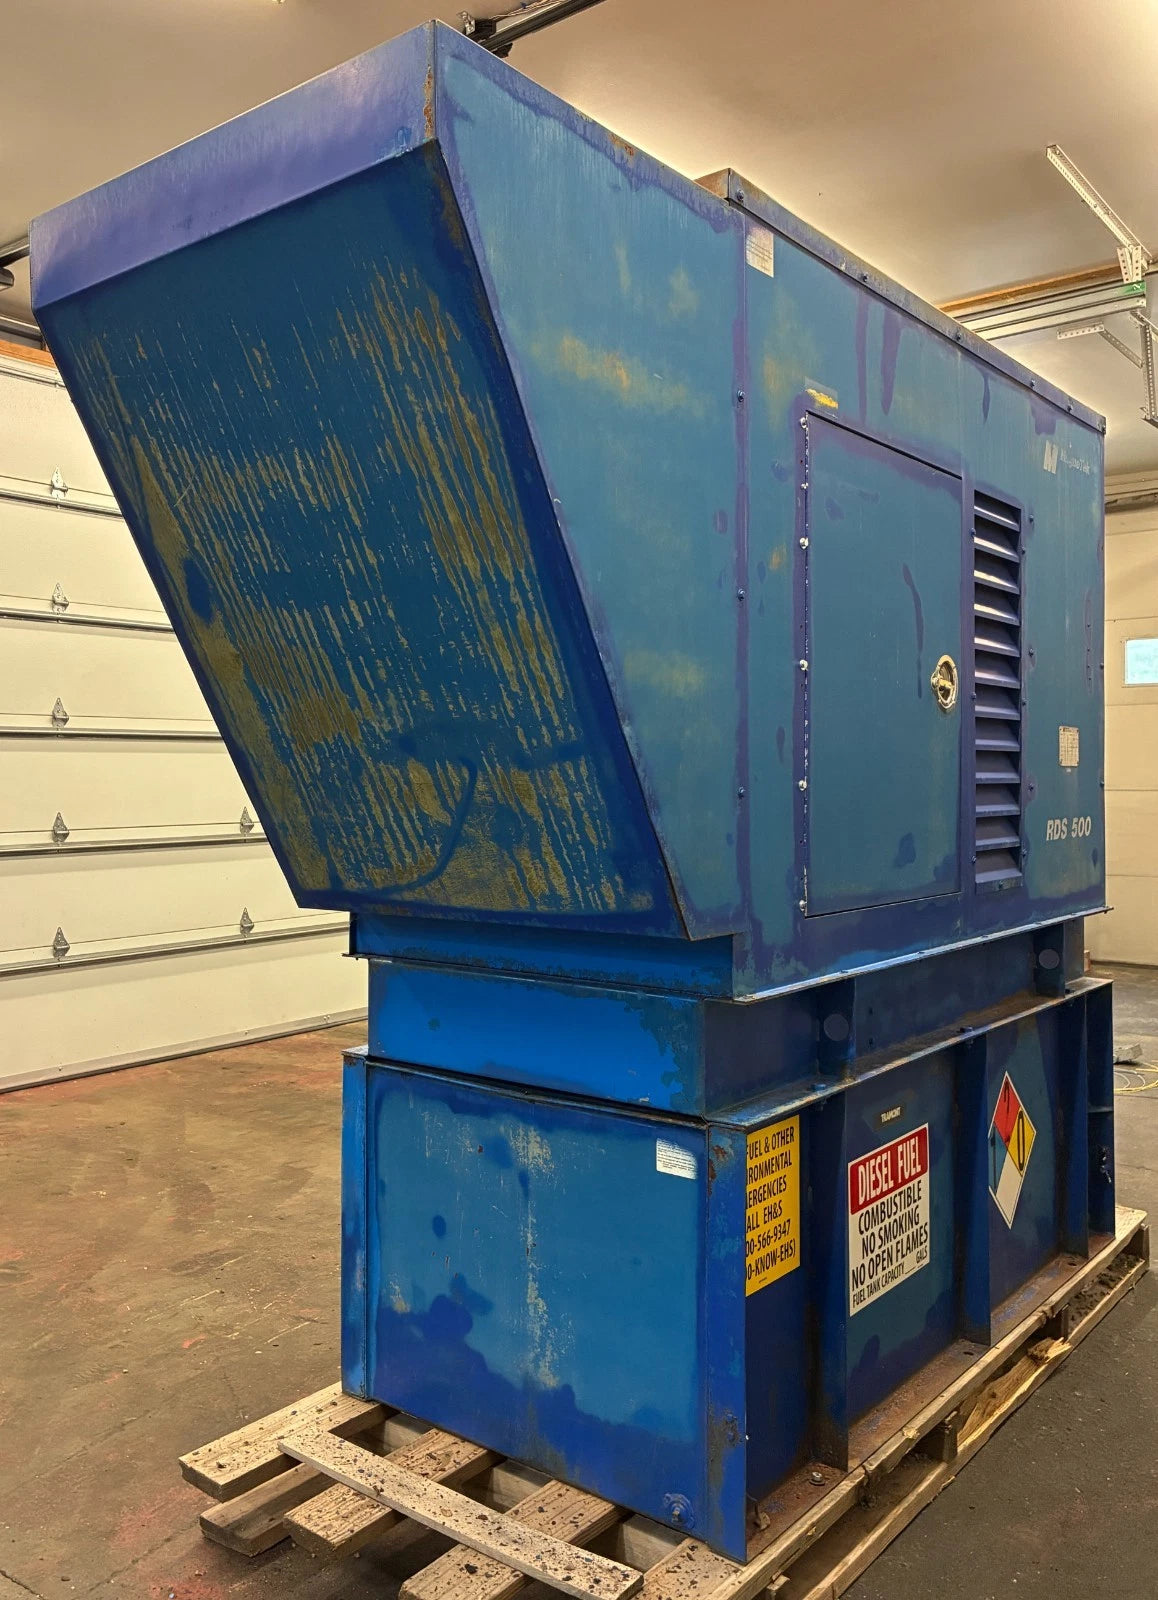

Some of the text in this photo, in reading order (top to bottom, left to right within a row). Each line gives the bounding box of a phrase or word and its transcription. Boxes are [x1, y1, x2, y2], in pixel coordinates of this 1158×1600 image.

[1046, 816, 1091, 841] RDS 500
[764, 1136, 770, 1154] &
[771, 1126, 795, 1150] OTHER
[746, 1174, 787, 1209] ERGENCIES
[858, 1136, 922, 1206] DIESEL FUEL
[763, 1200, 782, 1225] EH&S
[858, 1180, 922, 1236] COMBUSTIBLE
[862, 1205, 920, 1259] NO SMOKING
[746, 1238, 796, 1280] 0-KNOW-EHS)
[852, 1222, 928, 1291] NO OPEN FLAMES
[852, 1245, 928, 1309] FUEL TANK CAPACITY GALS
